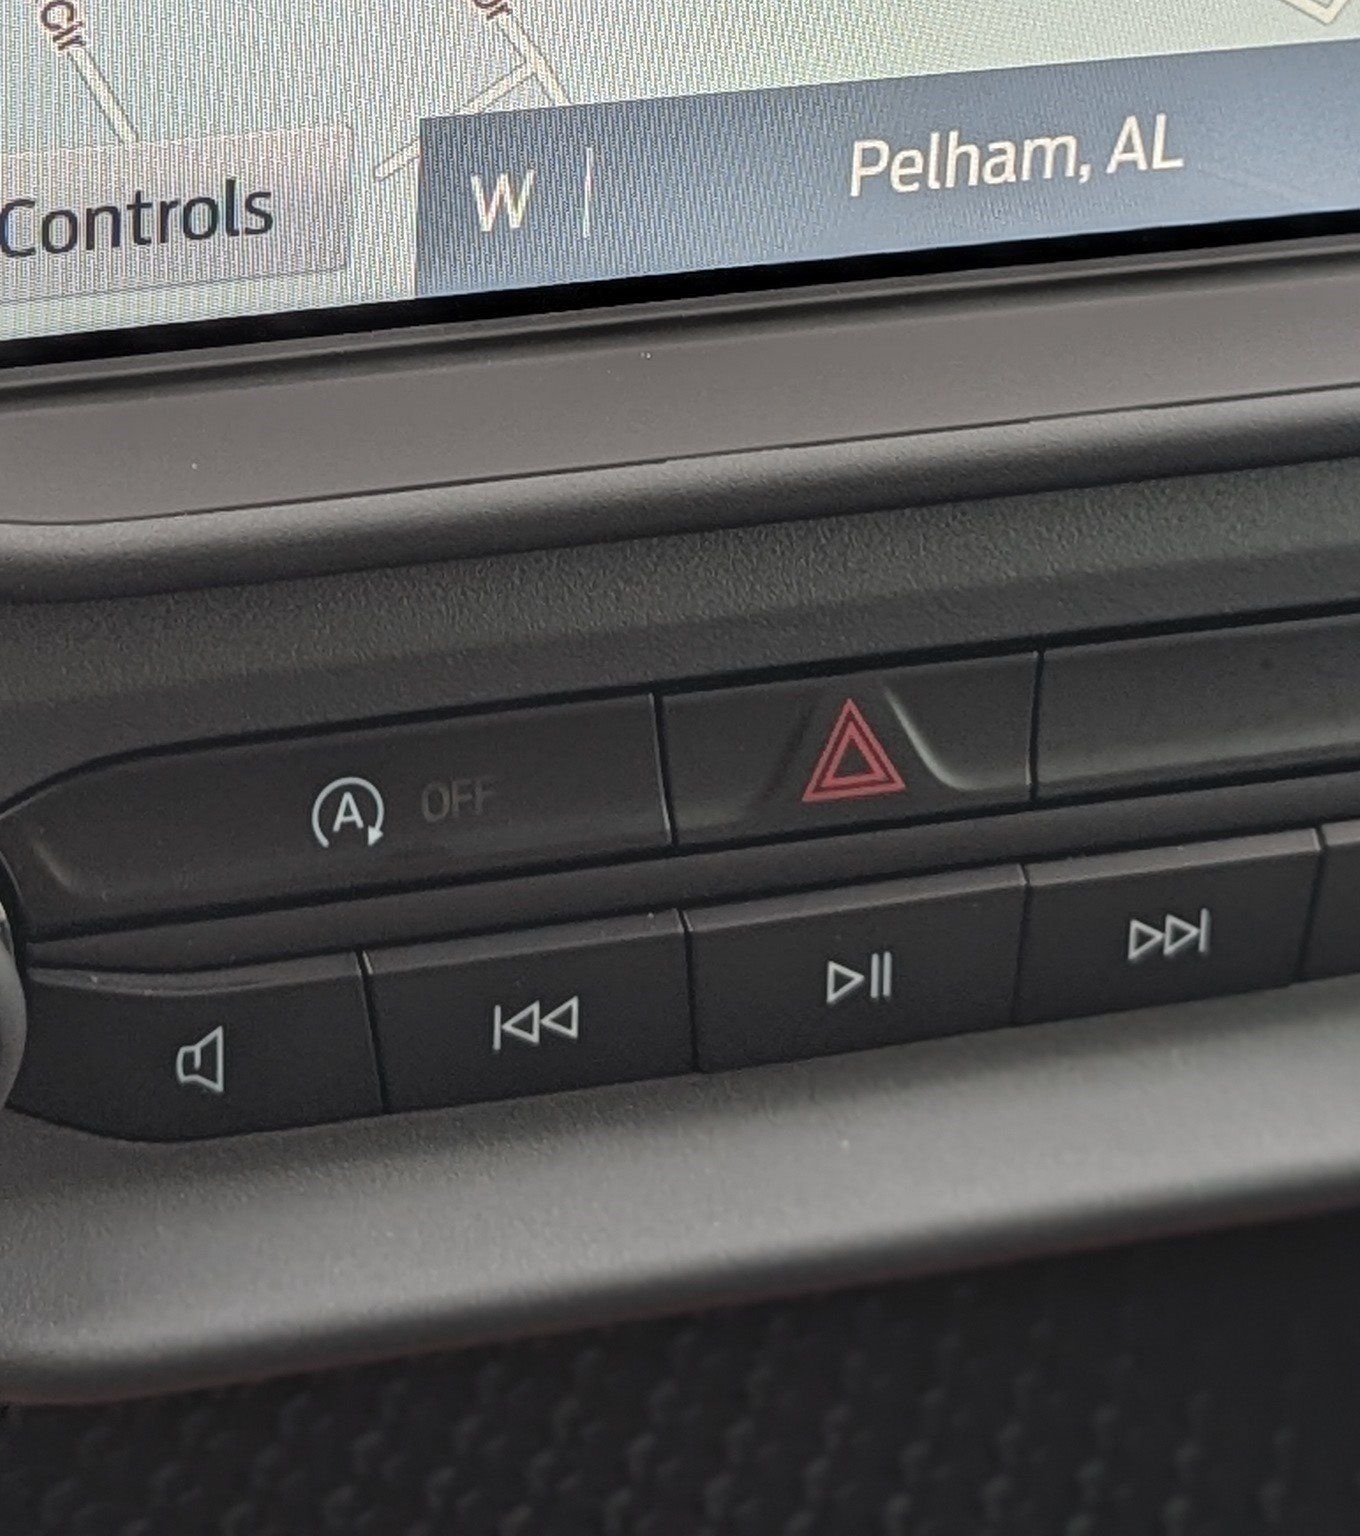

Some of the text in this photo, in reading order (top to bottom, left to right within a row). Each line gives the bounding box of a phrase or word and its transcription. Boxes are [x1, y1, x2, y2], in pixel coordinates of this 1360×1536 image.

[40, 0, 87, 52] Cir
[850, 112, 1185, 198] Pelham, AL
[470, 168, 535, 233] W
[421, 776, 495, 823] OFF
